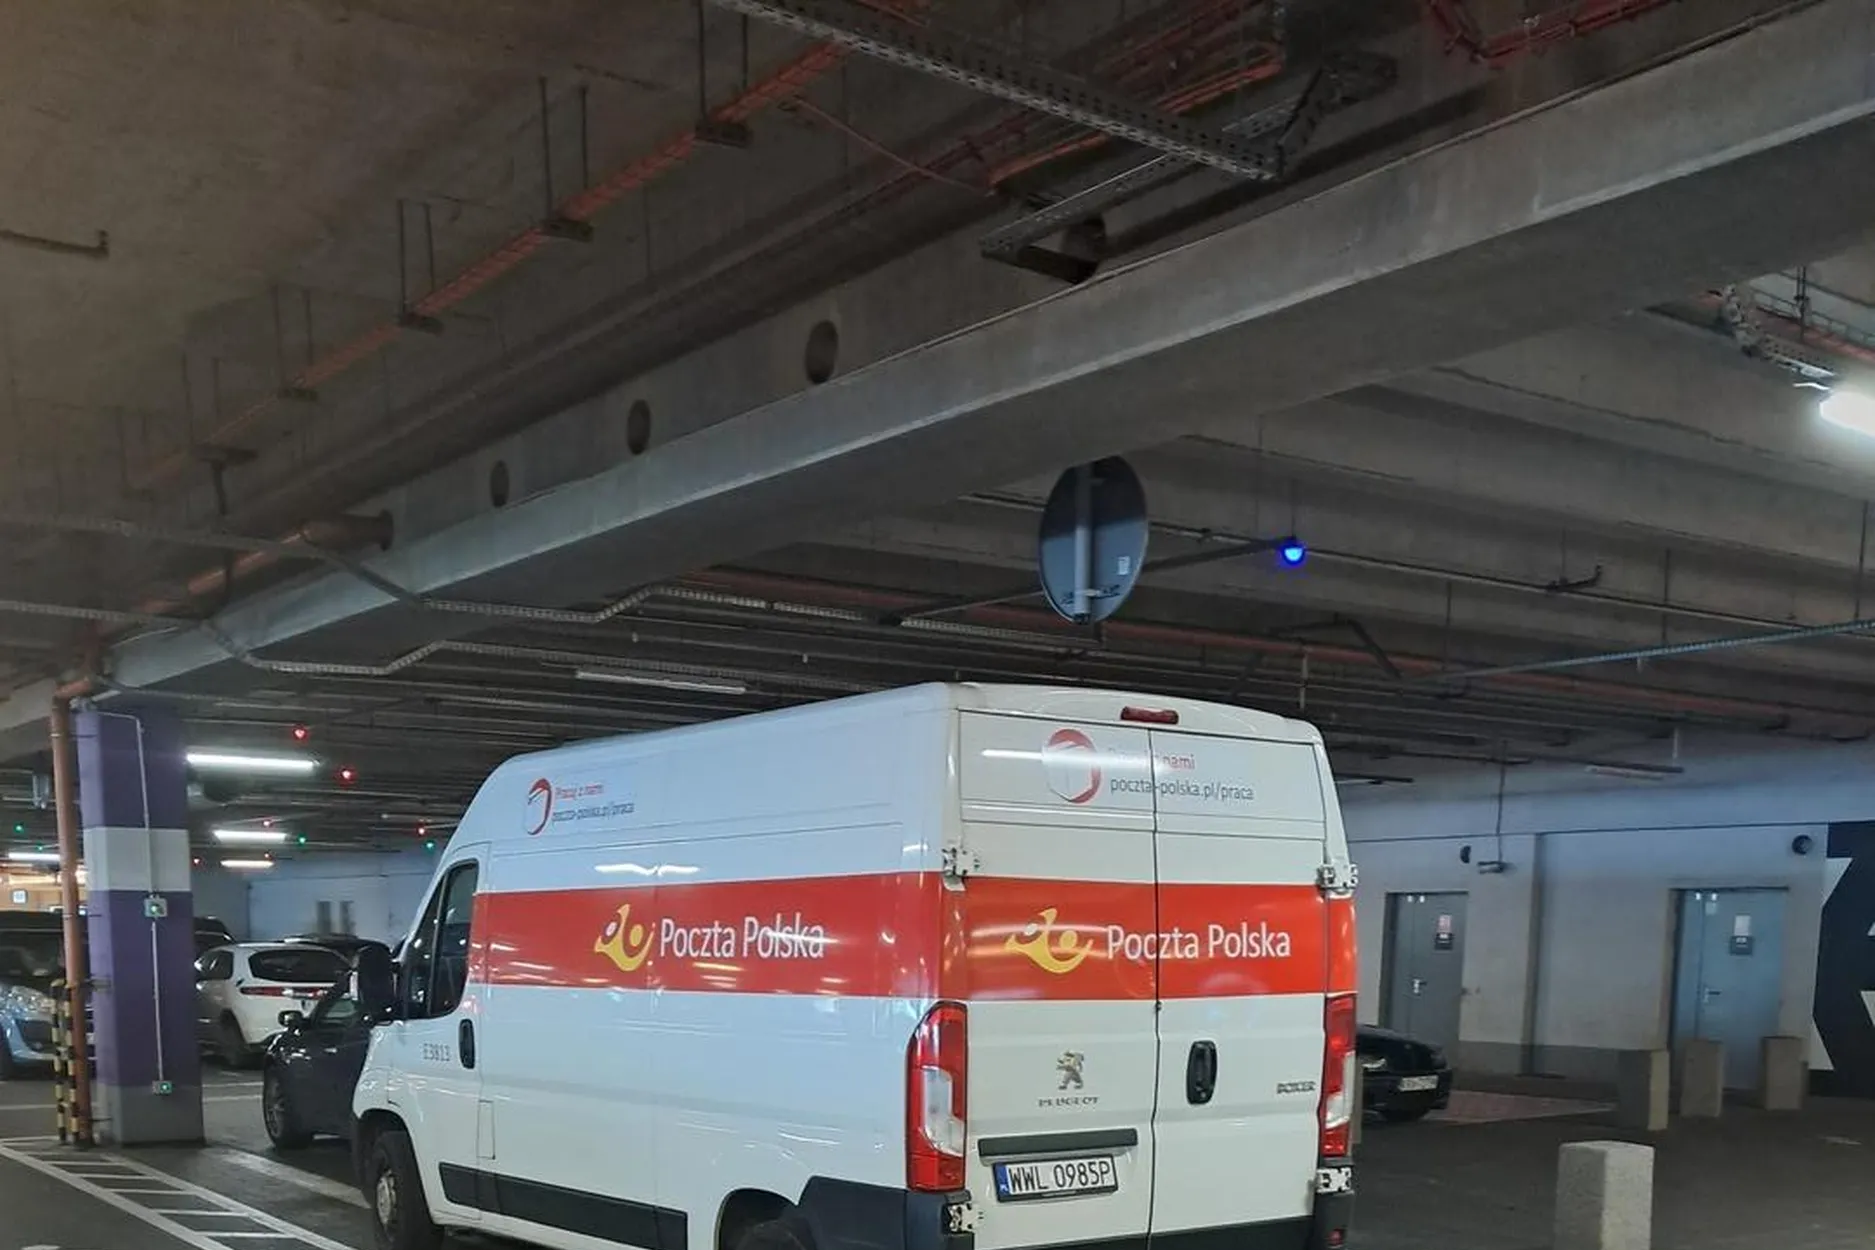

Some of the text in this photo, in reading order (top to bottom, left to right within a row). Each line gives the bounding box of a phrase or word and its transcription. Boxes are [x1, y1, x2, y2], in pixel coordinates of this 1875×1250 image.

[660, 911, 825, 959] Poczta Polska
[1107, 921, 1292, 960] Poczta Polska
[1008, 1160, 1111, 1193] WWL 0985P
